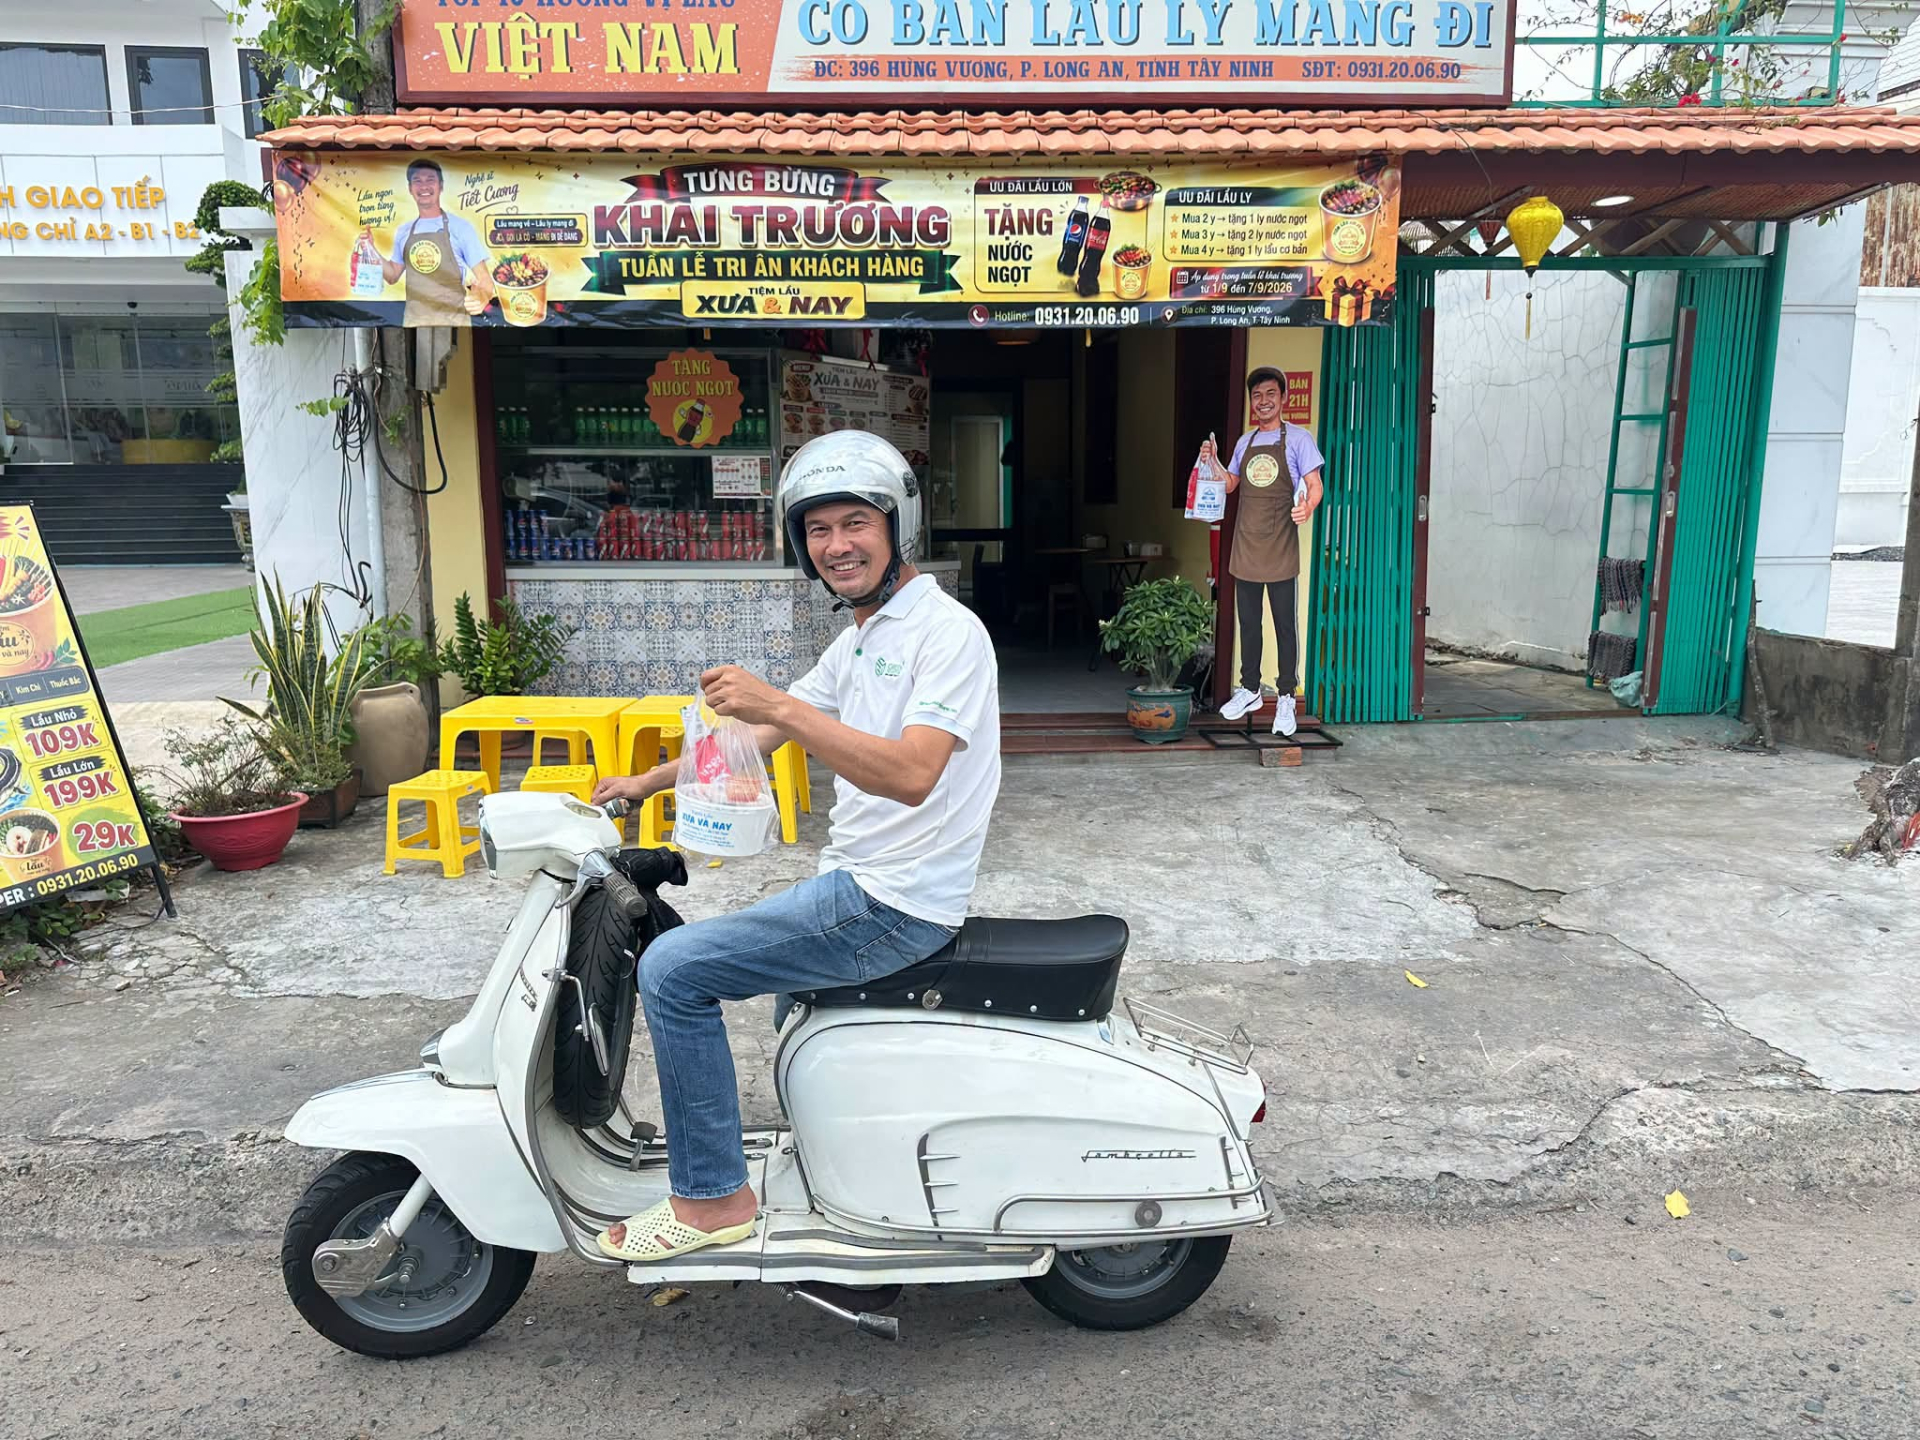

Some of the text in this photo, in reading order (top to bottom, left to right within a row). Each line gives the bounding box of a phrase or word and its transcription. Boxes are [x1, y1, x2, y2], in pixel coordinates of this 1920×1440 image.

[1164, 0, 1231, 46] LY
[1254, 0, 1416, 47] MANG
[1434, 2, 1495, 48] ĐI
[434, 13, 741, 80] VIỆT NAM
[815, 61, 843, 78] ĐC:
[850, 61, 880, 78] 396
[887, 57, 937, 78] HÙNG
[945, 60, 1014, 81] VƯƠNG,
[1021, 61, 1037, 78] P.
[1044, 61, 1090, 78] LONG
[1098, 61, 1130, 80] AN,
[1188, 58, 1222, 78] TÂY
[1229, 61, 1274, 78] NINH
[1302, 61, 1342, 79] SĐT:
[1348, 61, 1462, 80] 0931.20.06.90
[684, 166, 835, 196] TƯNG BỪNG
[1008, 180, 1025, 193] ĐÃI
[1052, 180, 1073, 193] LỚN
[25, 185, 104, 209] GIAO
[111, 175, 166, 209] TIẾP
[457, 189, 481, 210] Tiết
[1196, 189, 1214, 203] ĐÃI
[1240, 192, 1252, 203] LY
[36, 216, 76, 240] CHỈ
[85, 223, 113, 241] A2
[131, 223, 153, 240] B1
[593, 200, 951, 248] KHAI TRƯƠNG
[984, 203, 1053, 241] TẶNG
[1182, 213, 1200, 223] Mua
[1203, 213, 1208, 223] 2
[1228, 214, 1247, 225] tặng
[1256, 213, 1264, 225] ly
[1288, 214, 1307, 226] ngọt
[1181, 229, 1200, 239] Mua
[1202, 229, 1208, 239] 3
[1228, 230, 1246, 241] tặng
[1248, 229, 1254, 239] 2
[1256, 230, 1263, 241] ly
[987, 240, 1033, 262] NƯỚC
[1181, 245, 1199, 255] Mua
[1201, 245, 1207, 254] 4
[1227, 245, 1245, 257] tặng
[619, 252, 924, 278] TUẦN LỄ TRI ÂN KHÁCH HÀNG
[987, 266, 1031, 287] NGỌT
[748, 287, 776, 297] TIỆM
[1212, 283, 1228, 293] 1/9
[1248, 282, 1293, 293] 7/9/2026
[695, 293, 854, 315] XƯA & NAY
[1211, 305, 1225, 314] 396
[994, 306, 1140, 325] Hotline: 0931.20.06.90
[1220, 317, 1237, 326] Long
[1274, 316, 1290, 324] Ninh
[853, 377, 879, 390] NAY
[1289, 394, 1308, 408] 21H
[15, 682, 41, 694] Kim Chi
[31, 708, 78, 727] Lẩu Nhỏ
[25, 722, 100, 757] 109K
[49, 760, 95, 778] Lẩu Lớn
[43, 771, 117, 807] 199K
[74, 821, 136, 851] 29K
[712, 821, 732, 831] NAY
[36, 853, 138, 896] 0931.20.06.90
